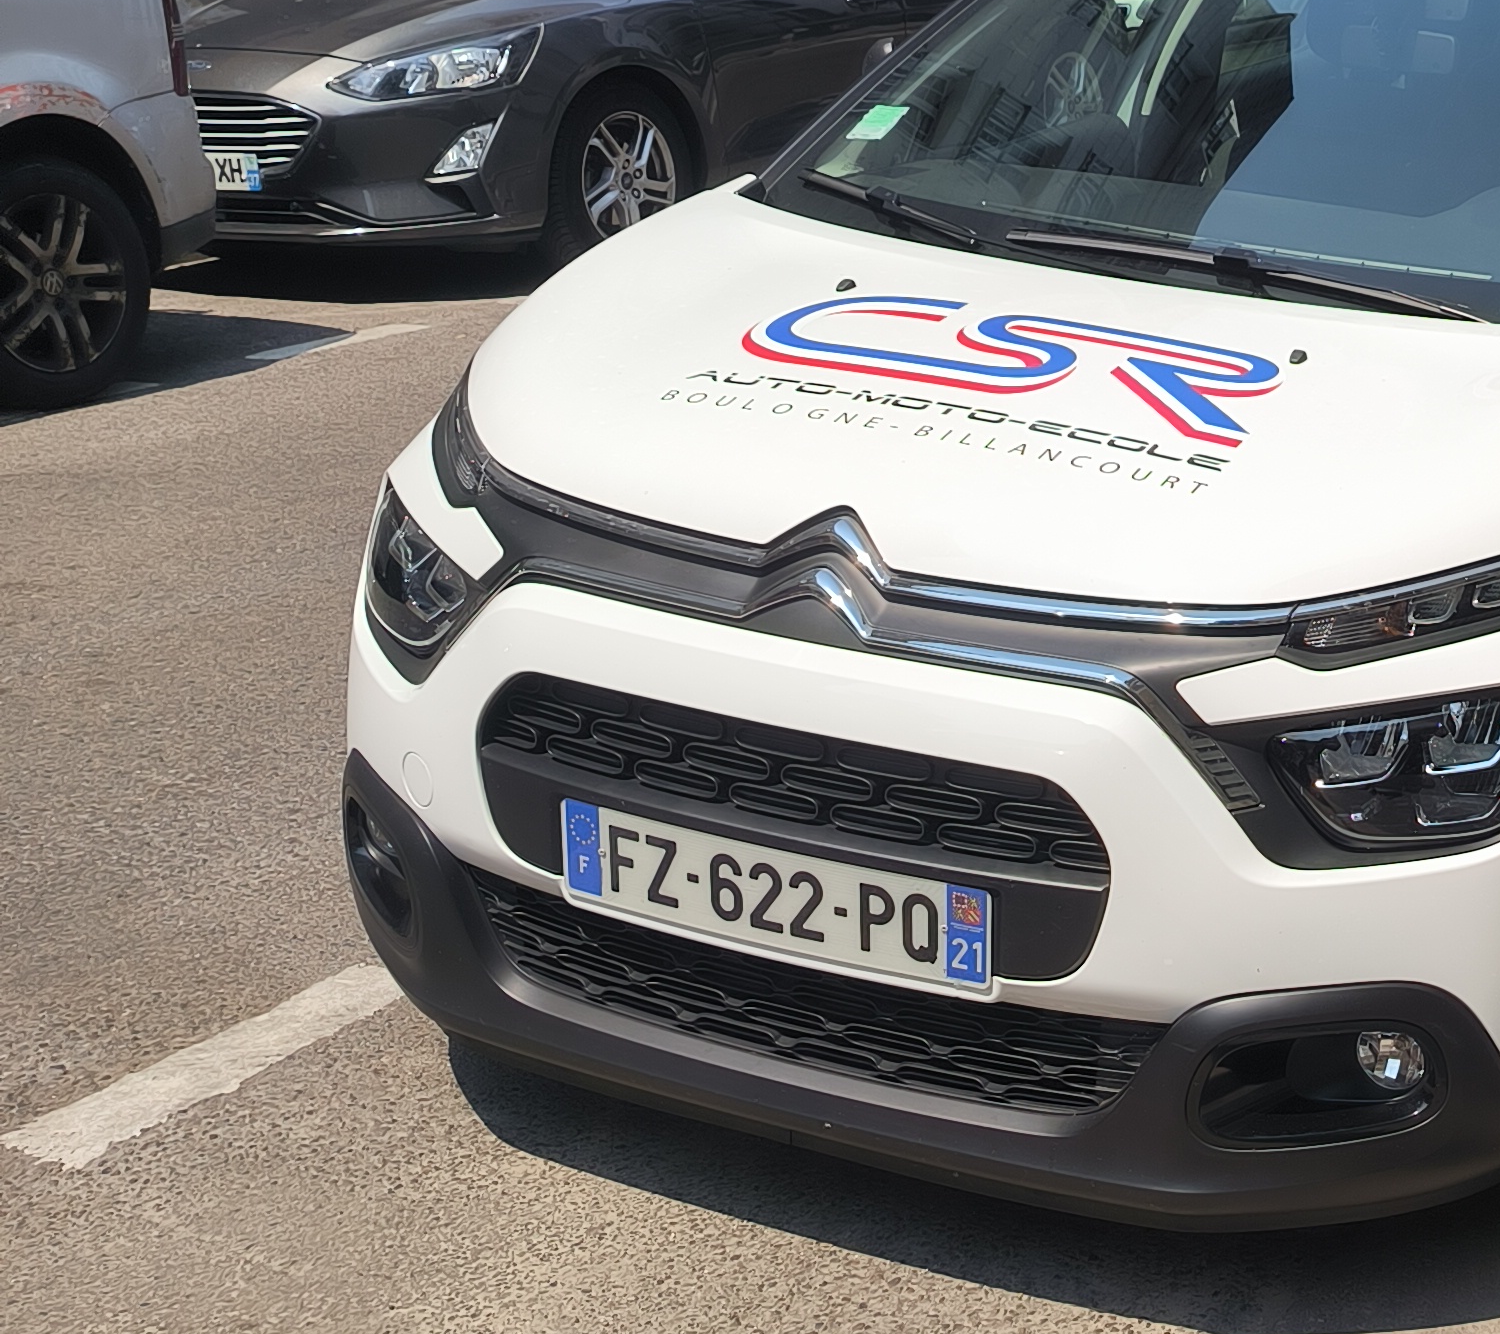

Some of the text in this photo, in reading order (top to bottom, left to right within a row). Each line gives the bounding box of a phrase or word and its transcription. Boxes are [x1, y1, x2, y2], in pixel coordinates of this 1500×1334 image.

[215, 158, 246, 183] XH
[685, 370, 1231, 473] AUTO-MOTO-ECOLE
[741, 296, 1285, 448] CSR
[659, 388, 1209, 496] BOULOGNE-BILLANCOURT
[578, 854, 590, 874] F
[607, 823, 940, 965] FZ-622-PQ
[951, 937, 983, 974] 21
